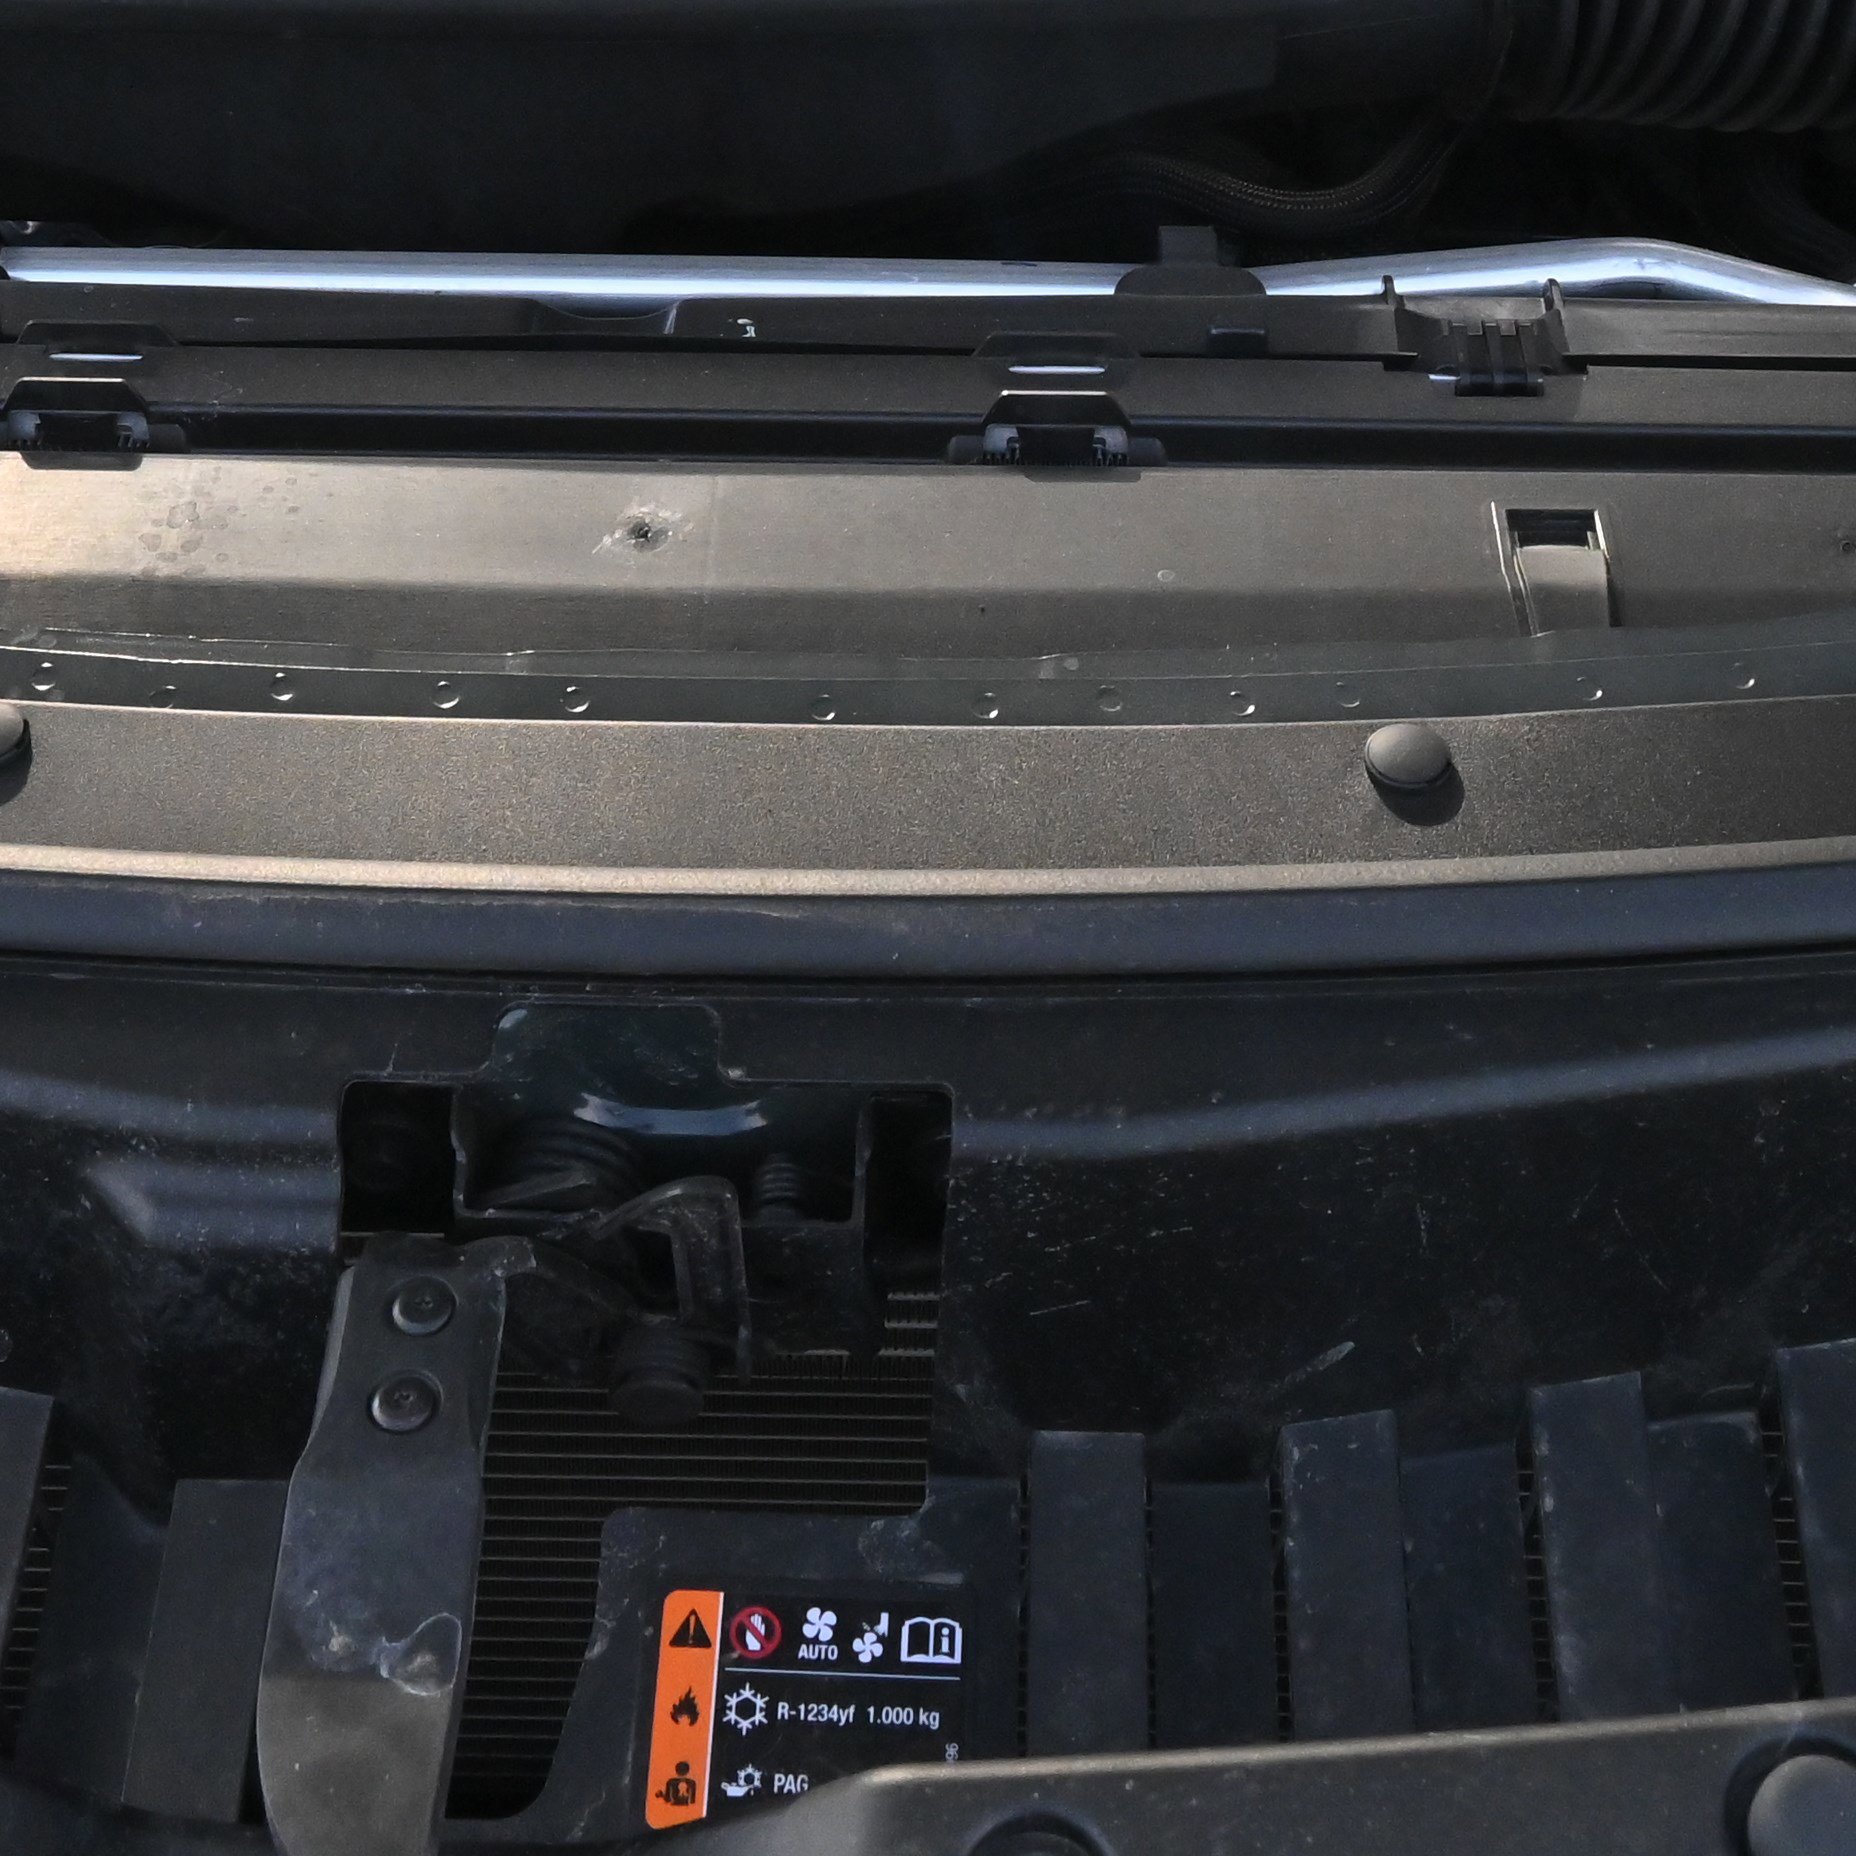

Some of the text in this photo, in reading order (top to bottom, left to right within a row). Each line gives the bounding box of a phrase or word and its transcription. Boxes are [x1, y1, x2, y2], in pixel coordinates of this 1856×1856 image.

[797, 1643, 839, 1661] AUTO
[776, 1701, 941, 1730] R-1234yf 1.000 kg
[773, 1772, 810, 1794] PAG
